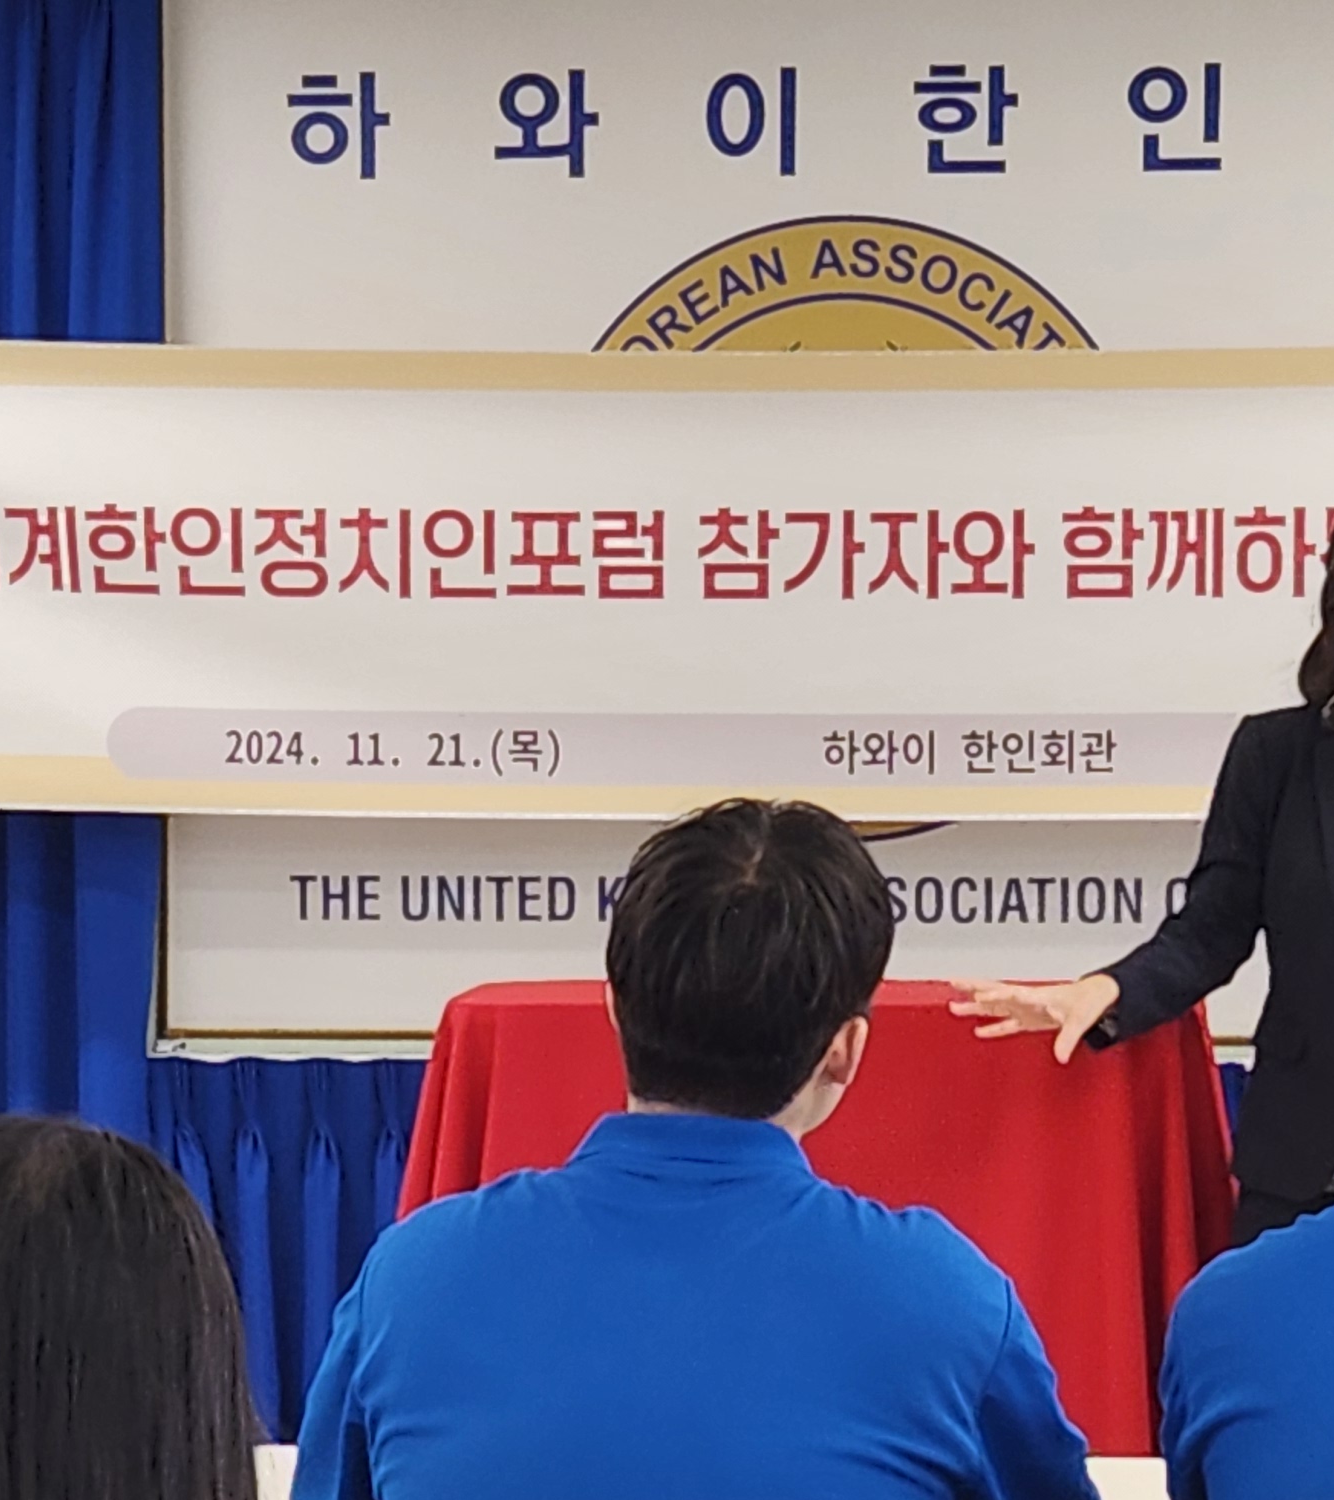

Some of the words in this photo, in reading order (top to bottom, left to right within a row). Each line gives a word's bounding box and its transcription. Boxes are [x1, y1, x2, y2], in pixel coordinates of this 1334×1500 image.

[810, 238, 1066, 350] ASSOCIAT
[697, 506, 1037, 602] 참가자와
[224, 729, 321, 768] 2024.
[346, 732, 402, 769] 11.
[426, 728, 562, 778] 21.(목)
[822, 729, 937, 777] 하와이
[961, 729, 1119, 775] 한인회관
[289, 875, 383, 923] THE
[401, 875, 578, 924] UNITED
[884, 876, 1144, 925] SOCIATION
